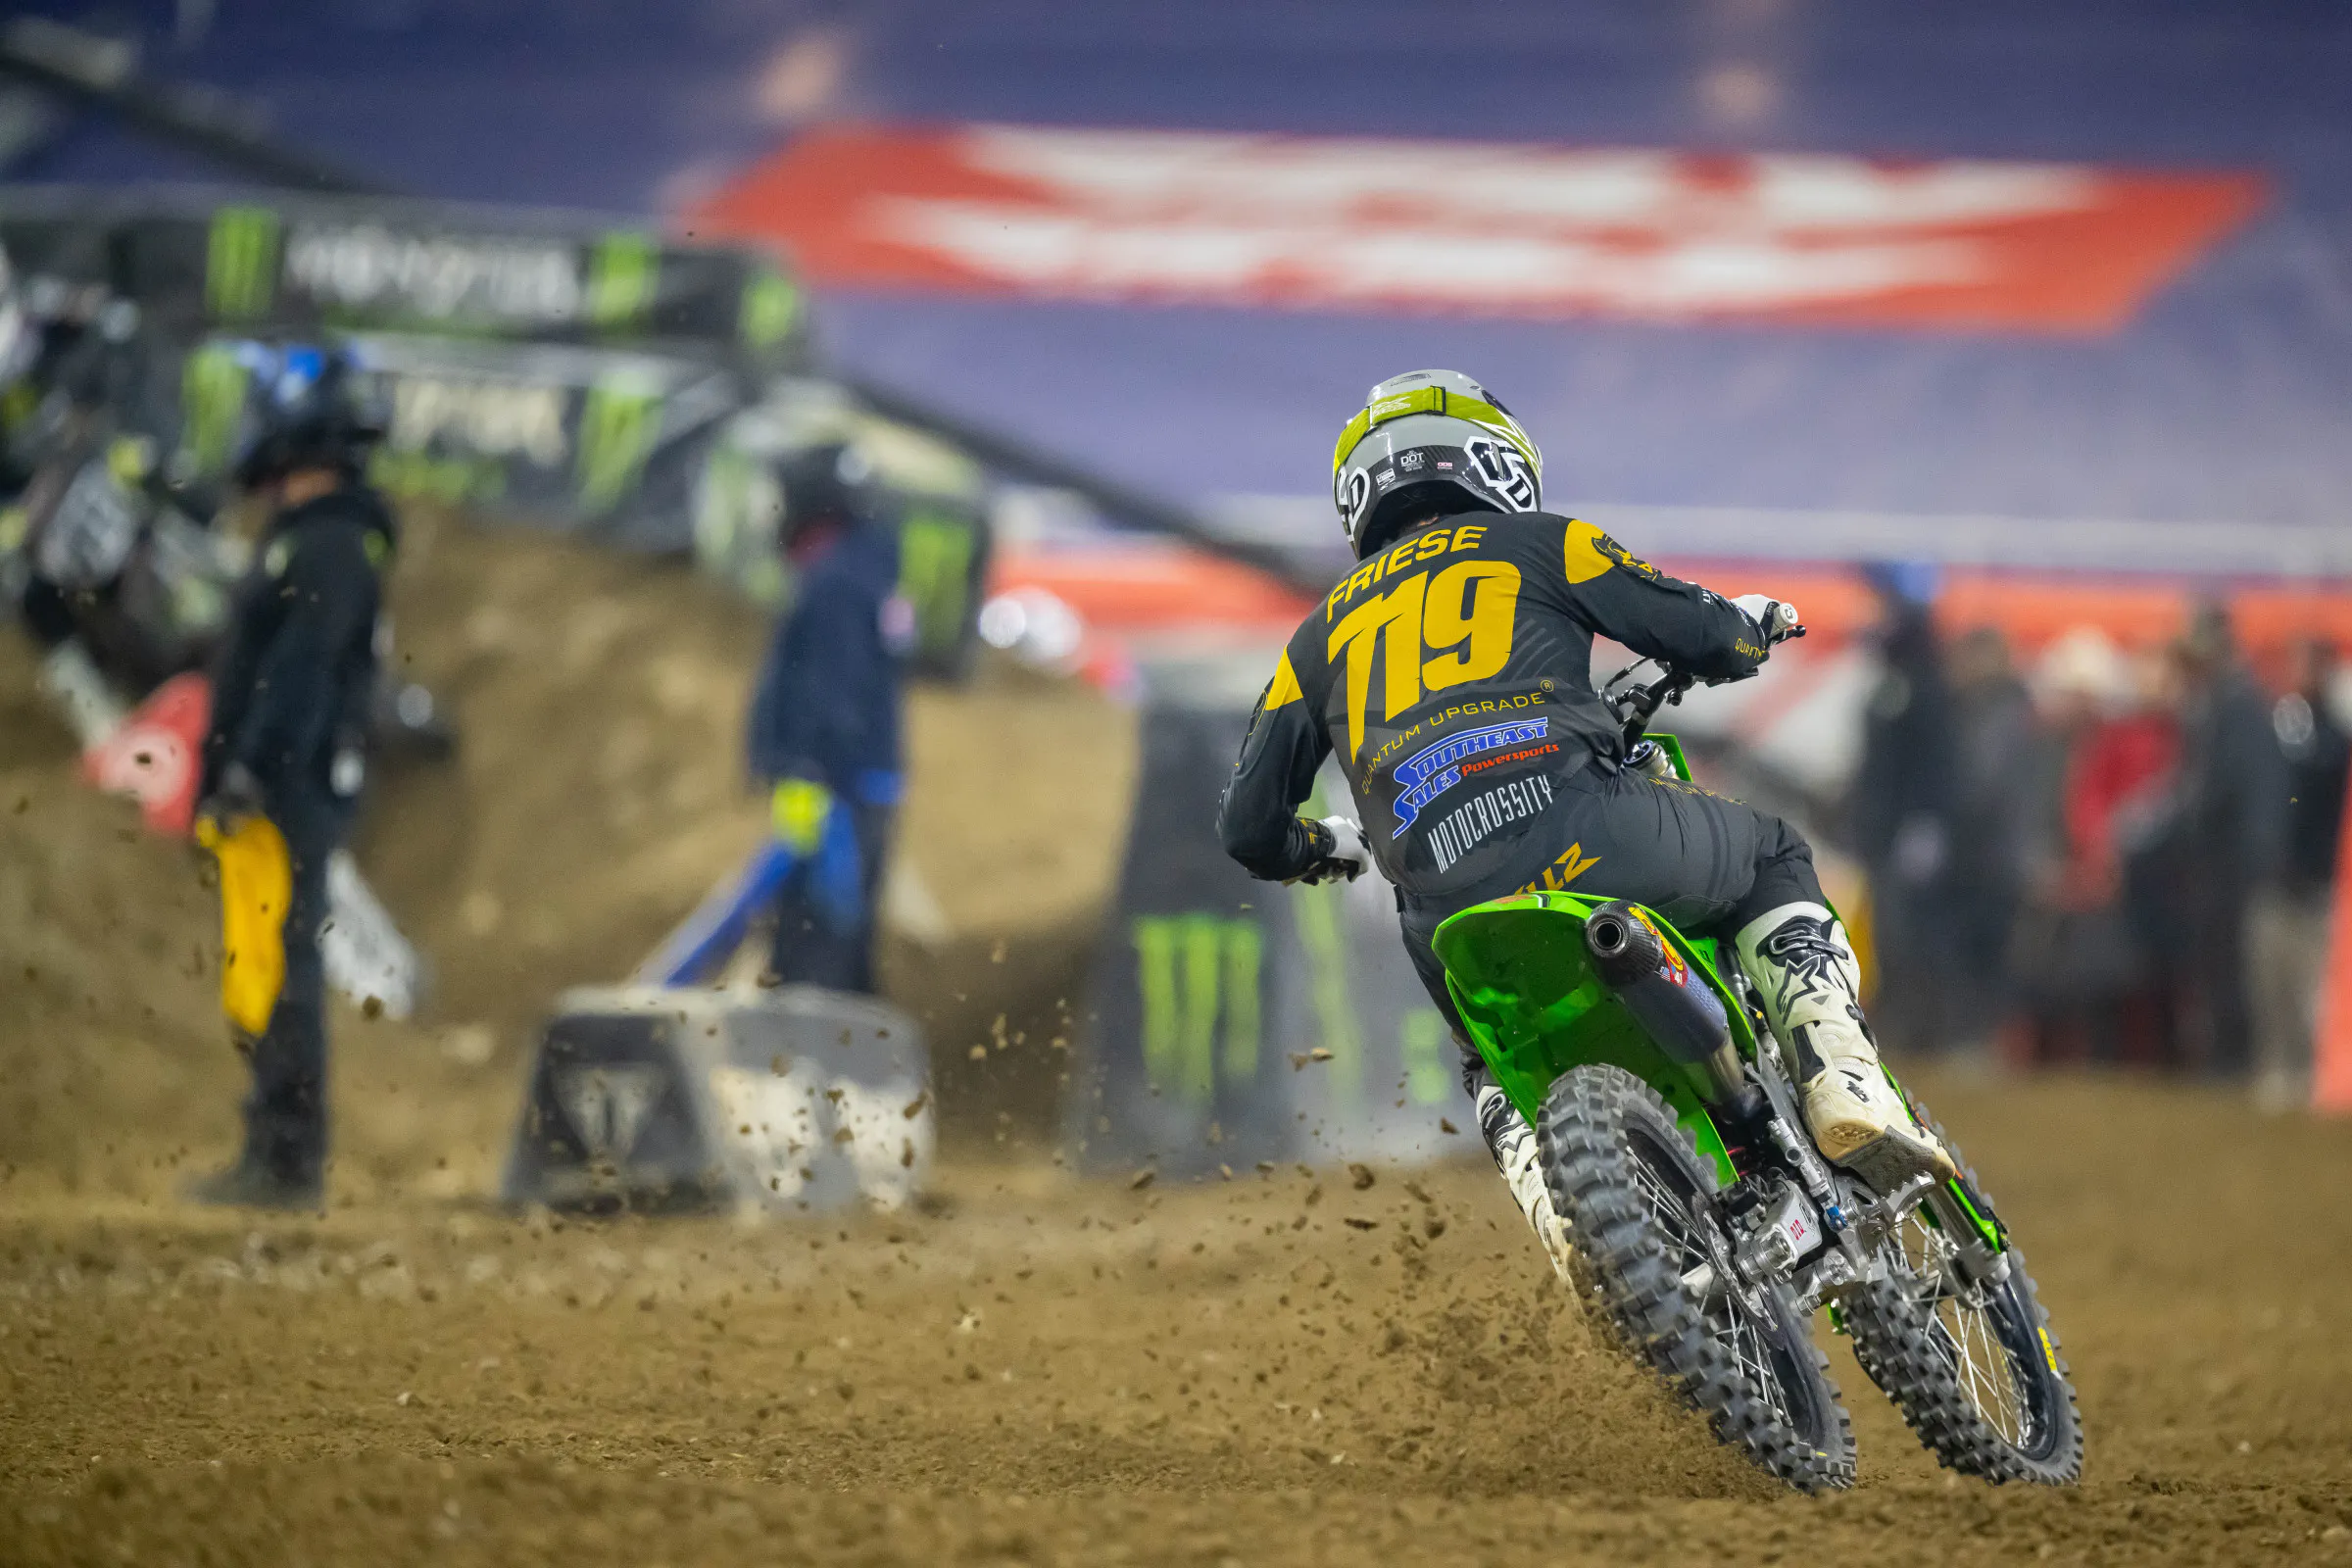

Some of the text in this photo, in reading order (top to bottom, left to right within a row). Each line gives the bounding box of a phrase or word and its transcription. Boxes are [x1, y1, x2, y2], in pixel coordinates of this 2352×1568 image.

[1400, 452, 1424, 466] DOT
[1326, 526, 1488, 623] FRIESE
[1328, 560, 1522, 765] 719
[1361, 724, 1421, 796] QUANTUM
[1393, 716, 1548, 790] SOUTHEAST
[1461, 744, 1559, 777] Powersports
[1393, 764, 1462, 840] SALES
[1427, 774, 1553, 874] MOTOCROSSITY
